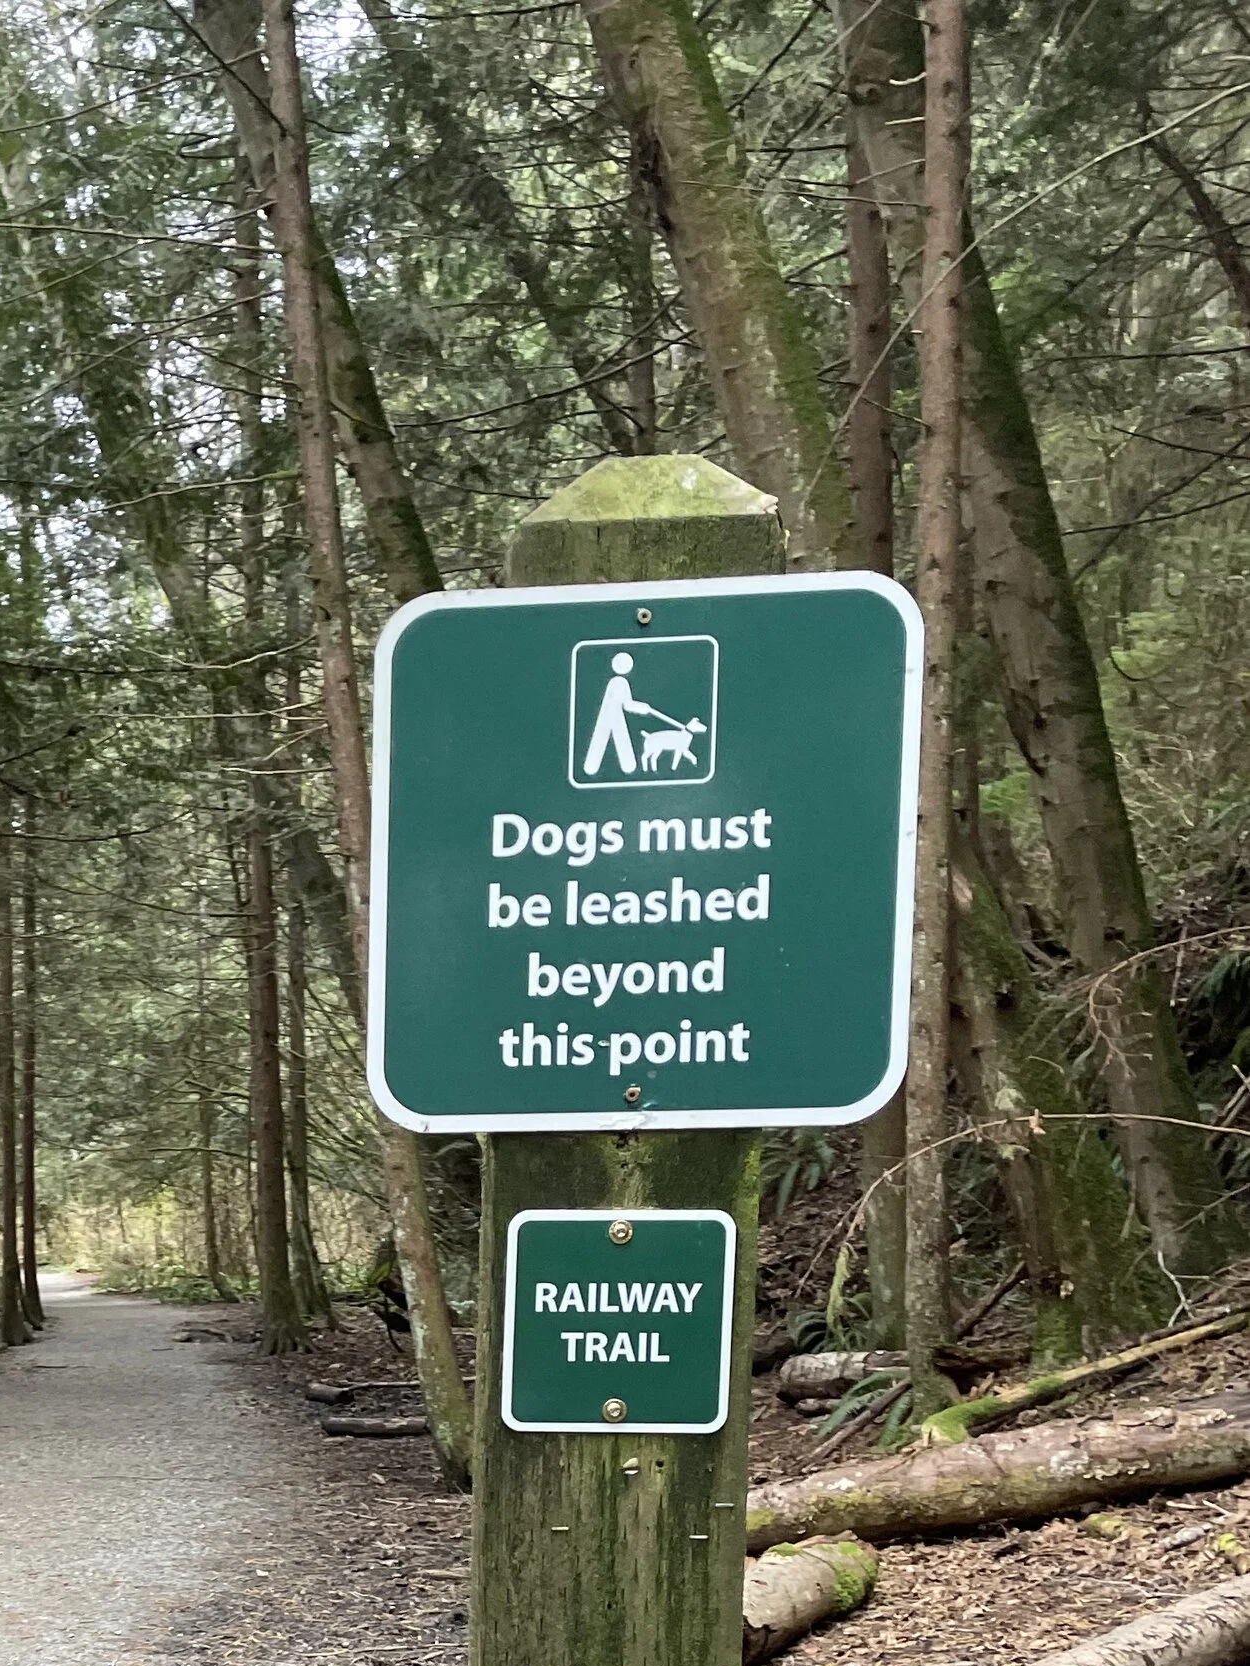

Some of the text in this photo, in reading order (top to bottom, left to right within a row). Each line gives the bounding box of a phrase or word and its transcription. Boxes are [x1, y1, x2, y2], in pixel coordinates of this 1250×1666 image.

[492, 808, 772, 867] Dogs must
[488, 873, 770, 928] be leashed
[527, 946, 725, 1008] beyond
[498, 1019, 750, 1076] this point
[534, 1282, 703, 1313] RAILWAY
[560, 1332, 670, 1363] TRAIL
